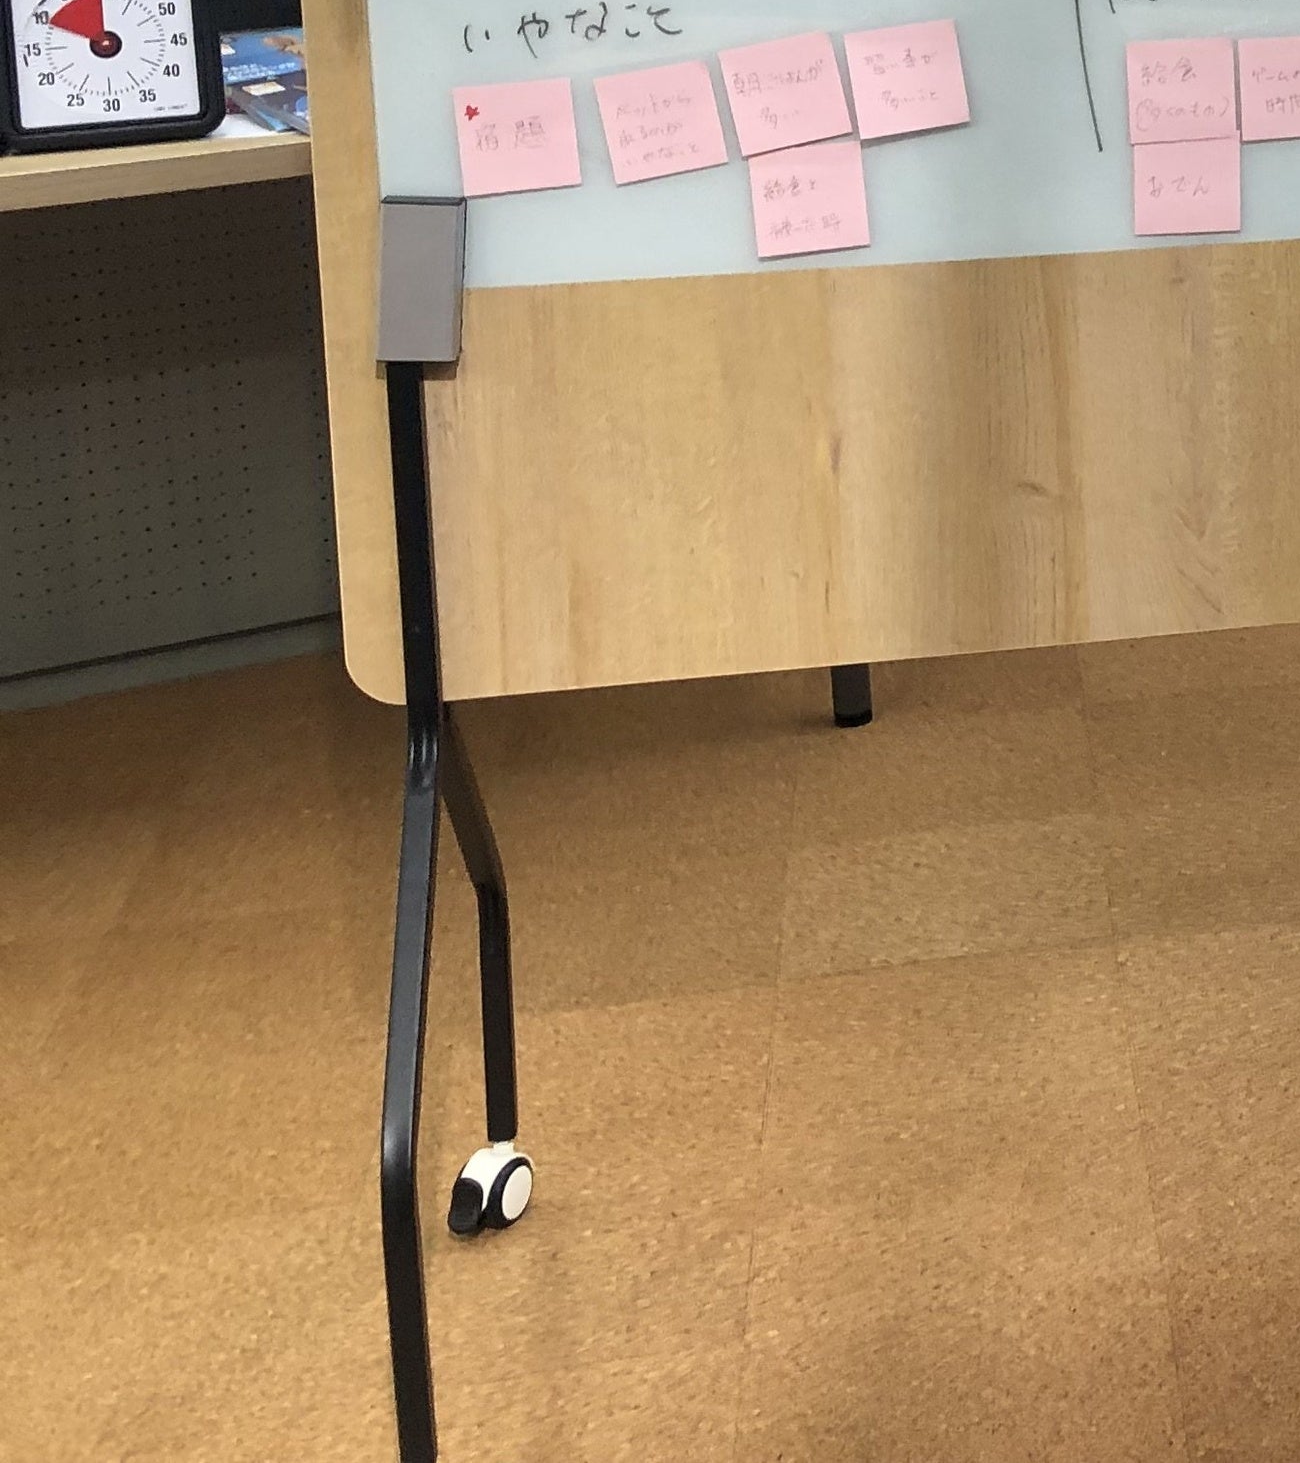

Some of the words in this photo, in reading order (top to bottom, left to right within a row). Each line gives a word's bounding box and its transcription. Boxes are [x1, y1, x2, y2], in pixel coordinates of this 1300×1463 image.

[158, 2, 176, 16] 50
[462, 0, 685, 60] いやなこと
[170, 33, 188, 46] 45
[25, 43, 42, 57] 15
[163, 64, 181, 78] 40
[38, 72, 55, 86] 20
[67, 93, 85, 108] 25
[139, 89, 156, 103] 35
[103, 98, 121, 112] 30
